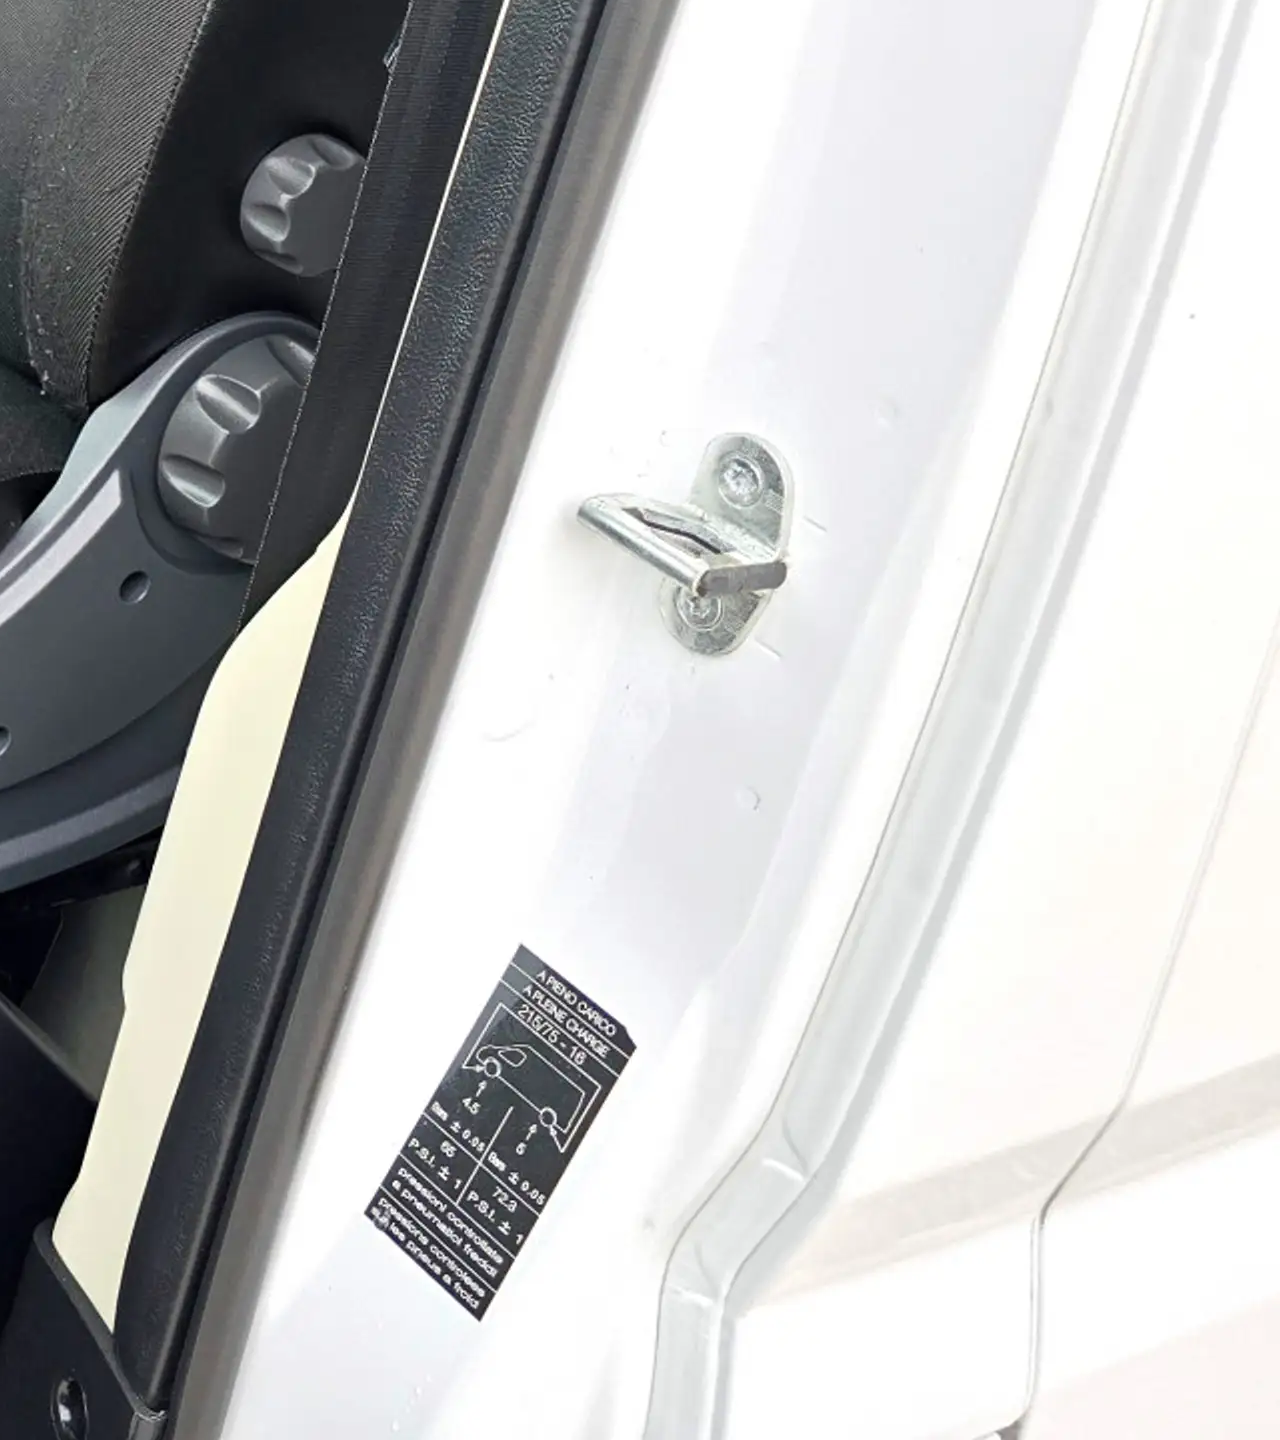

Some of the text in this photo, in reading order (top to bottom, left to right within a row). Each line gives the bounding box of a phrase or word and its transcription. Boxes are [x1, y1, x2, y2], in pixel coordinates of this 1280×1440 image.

[517, 1003, 561, 1044] 215/75
[565, 1018, 610, 1058] CHARGE
[576, 1001, 617, 1037] CARICO
